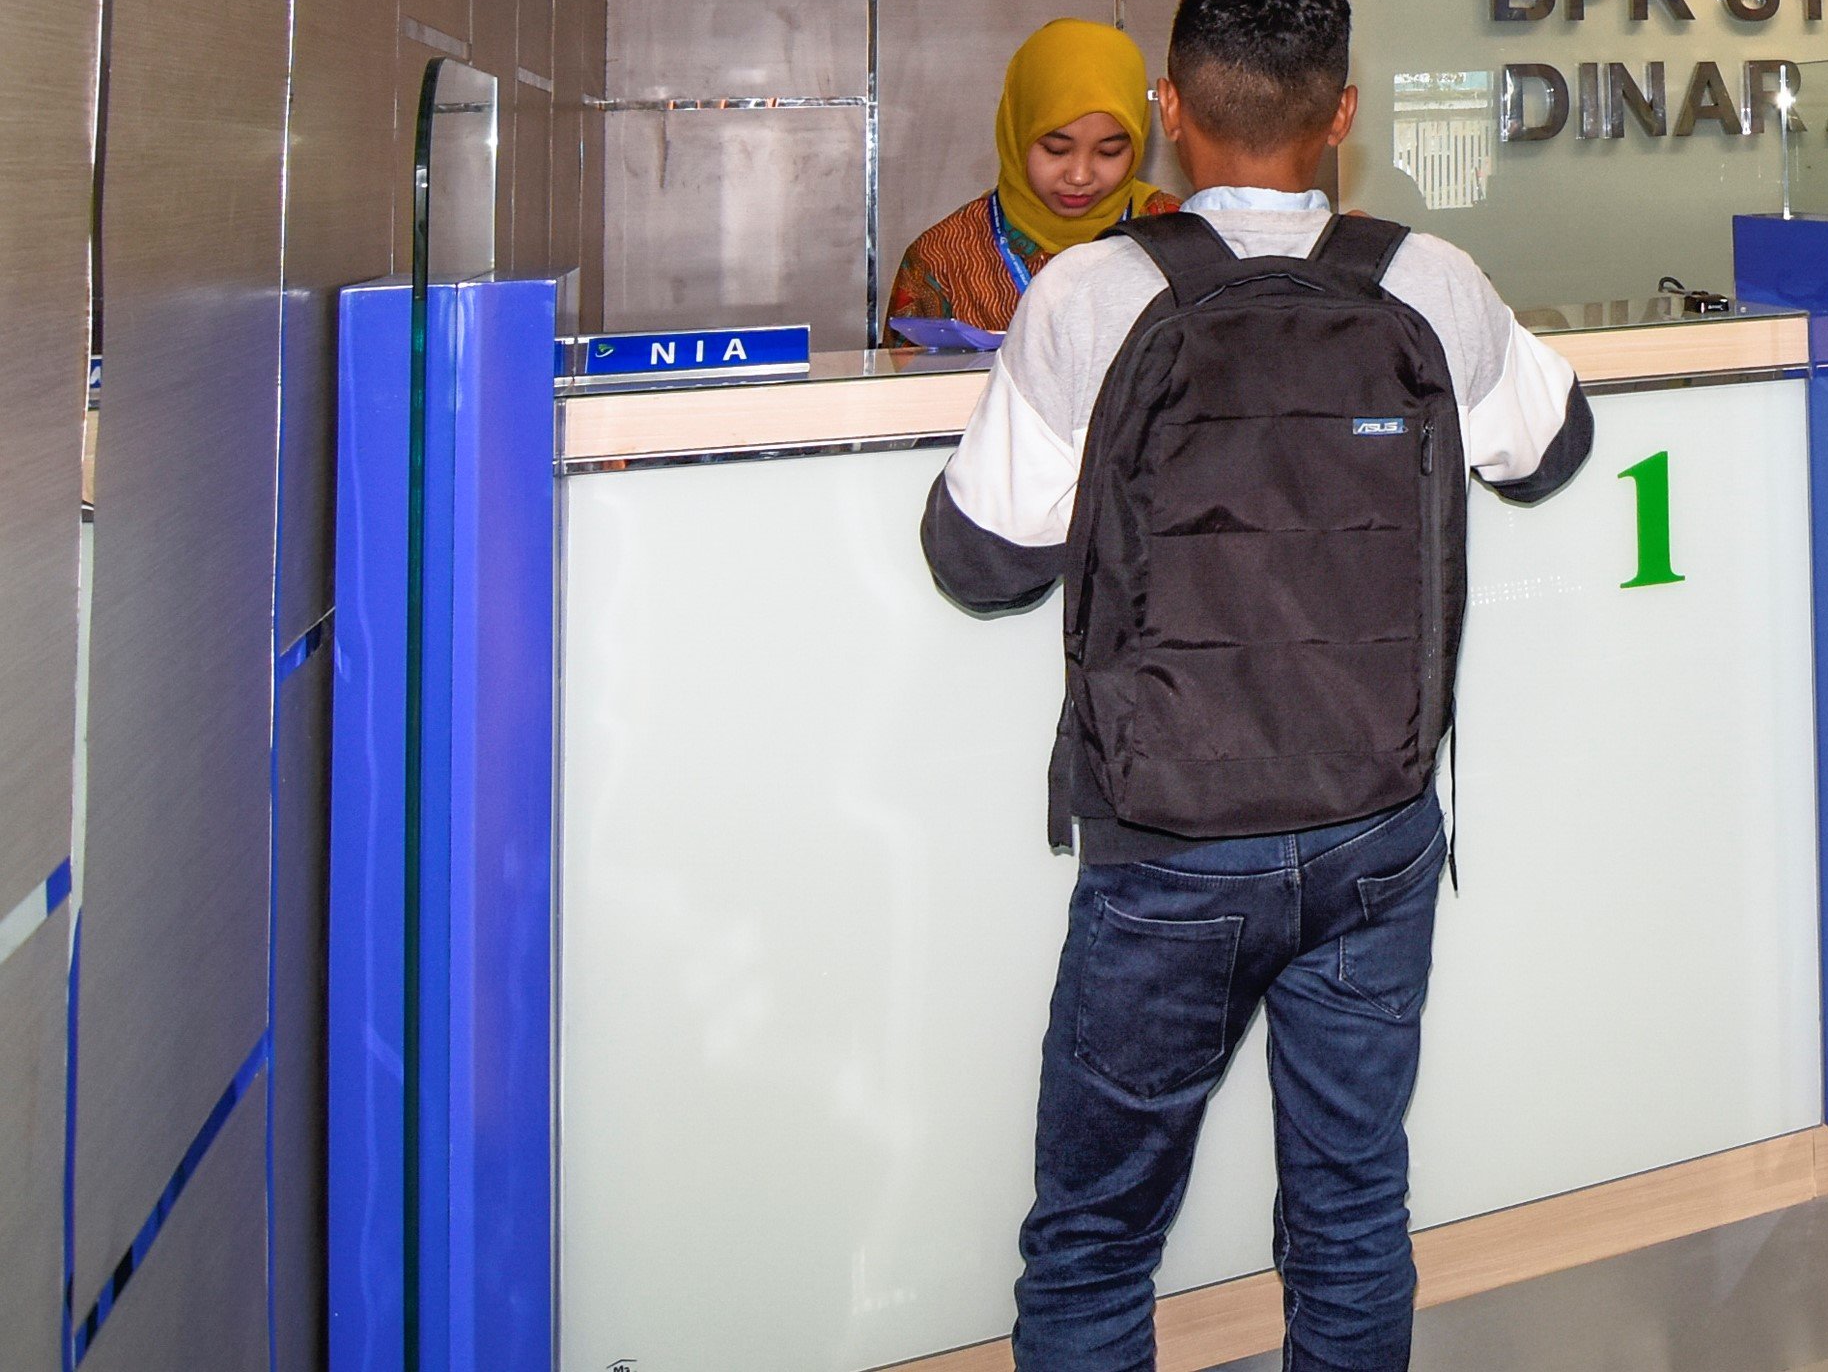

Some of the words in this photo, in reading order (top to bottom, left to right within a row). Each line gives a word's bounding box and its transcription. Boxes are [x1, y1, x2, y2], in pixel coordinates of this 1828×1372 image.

[1500, 59, 1806, 142] DINAR
[650, 338, 748, 365] NIA
[1357, 421, 1398, 433] ASUS
[1617, 451, 1686, 589] 1
